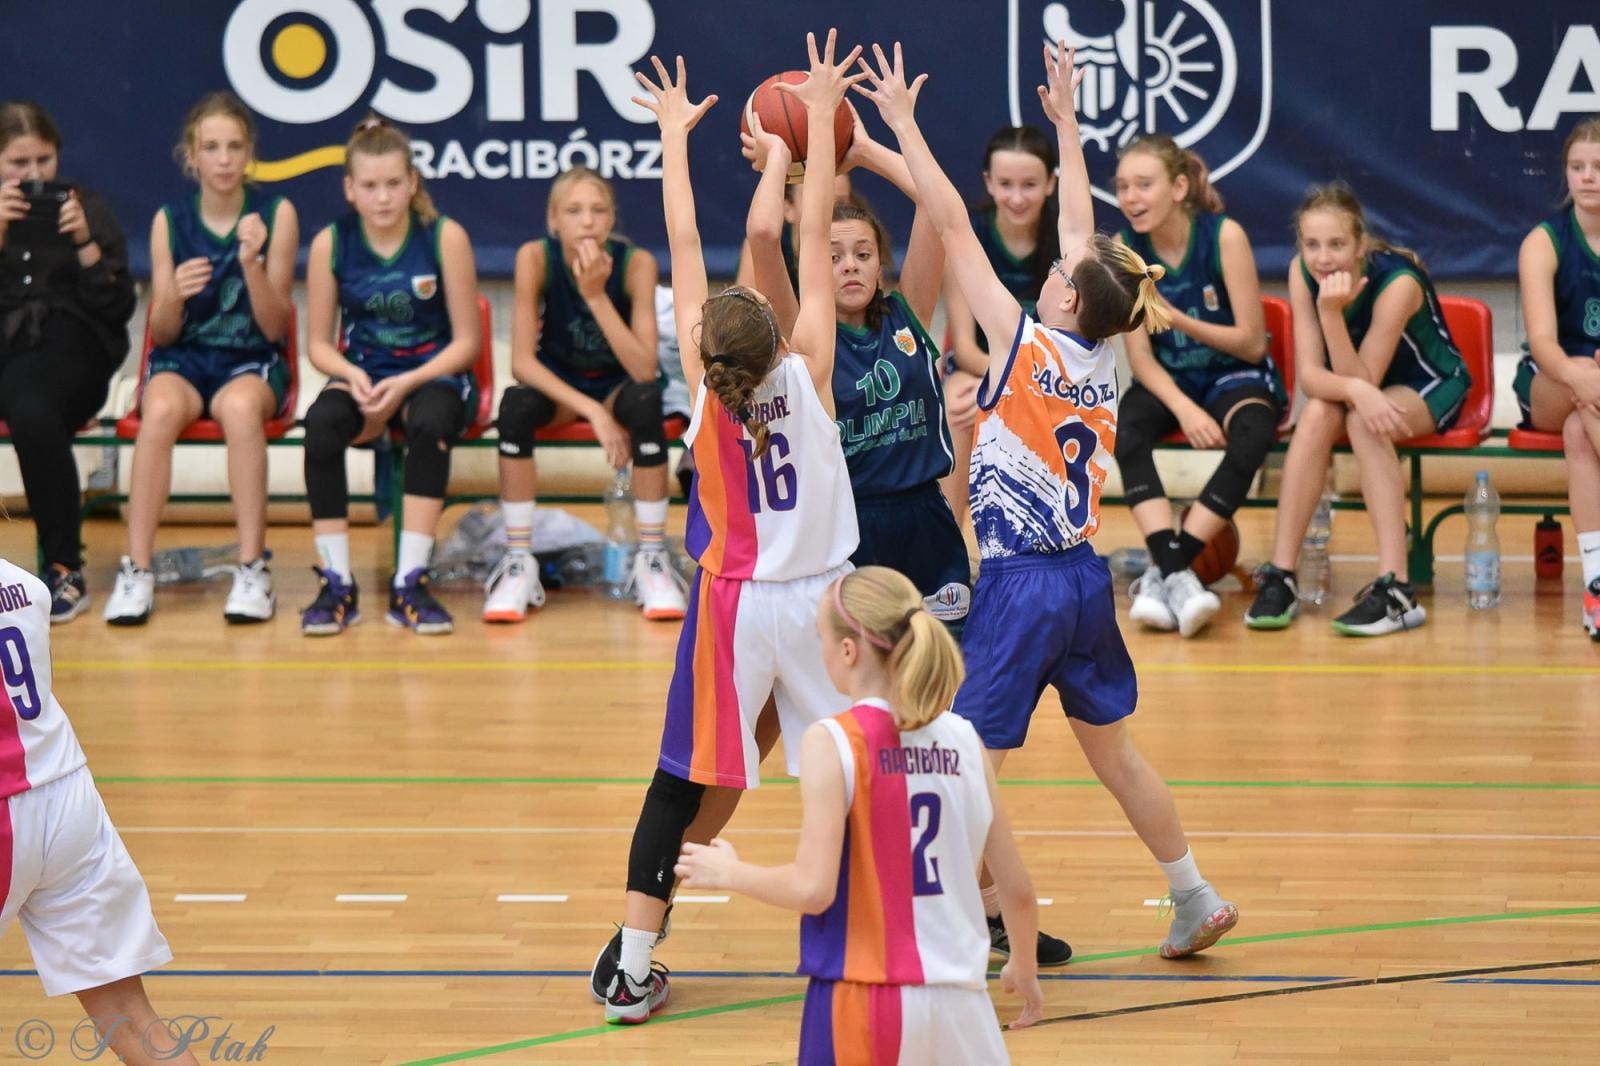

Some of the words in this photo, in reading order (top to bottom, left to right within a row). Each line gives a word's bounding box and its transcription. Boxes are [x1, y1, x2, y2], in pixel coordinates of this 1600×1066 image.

[1430, 25, 1600, 132] RA
[409, 128, 664, 181] RACIBÓRZ
[856, 358, 901, 407] 10
[735, 432, 798, 514] 16
[879, 740, 961, 777] RACIBÓRZ
[910, 791, 945, 897] 2
